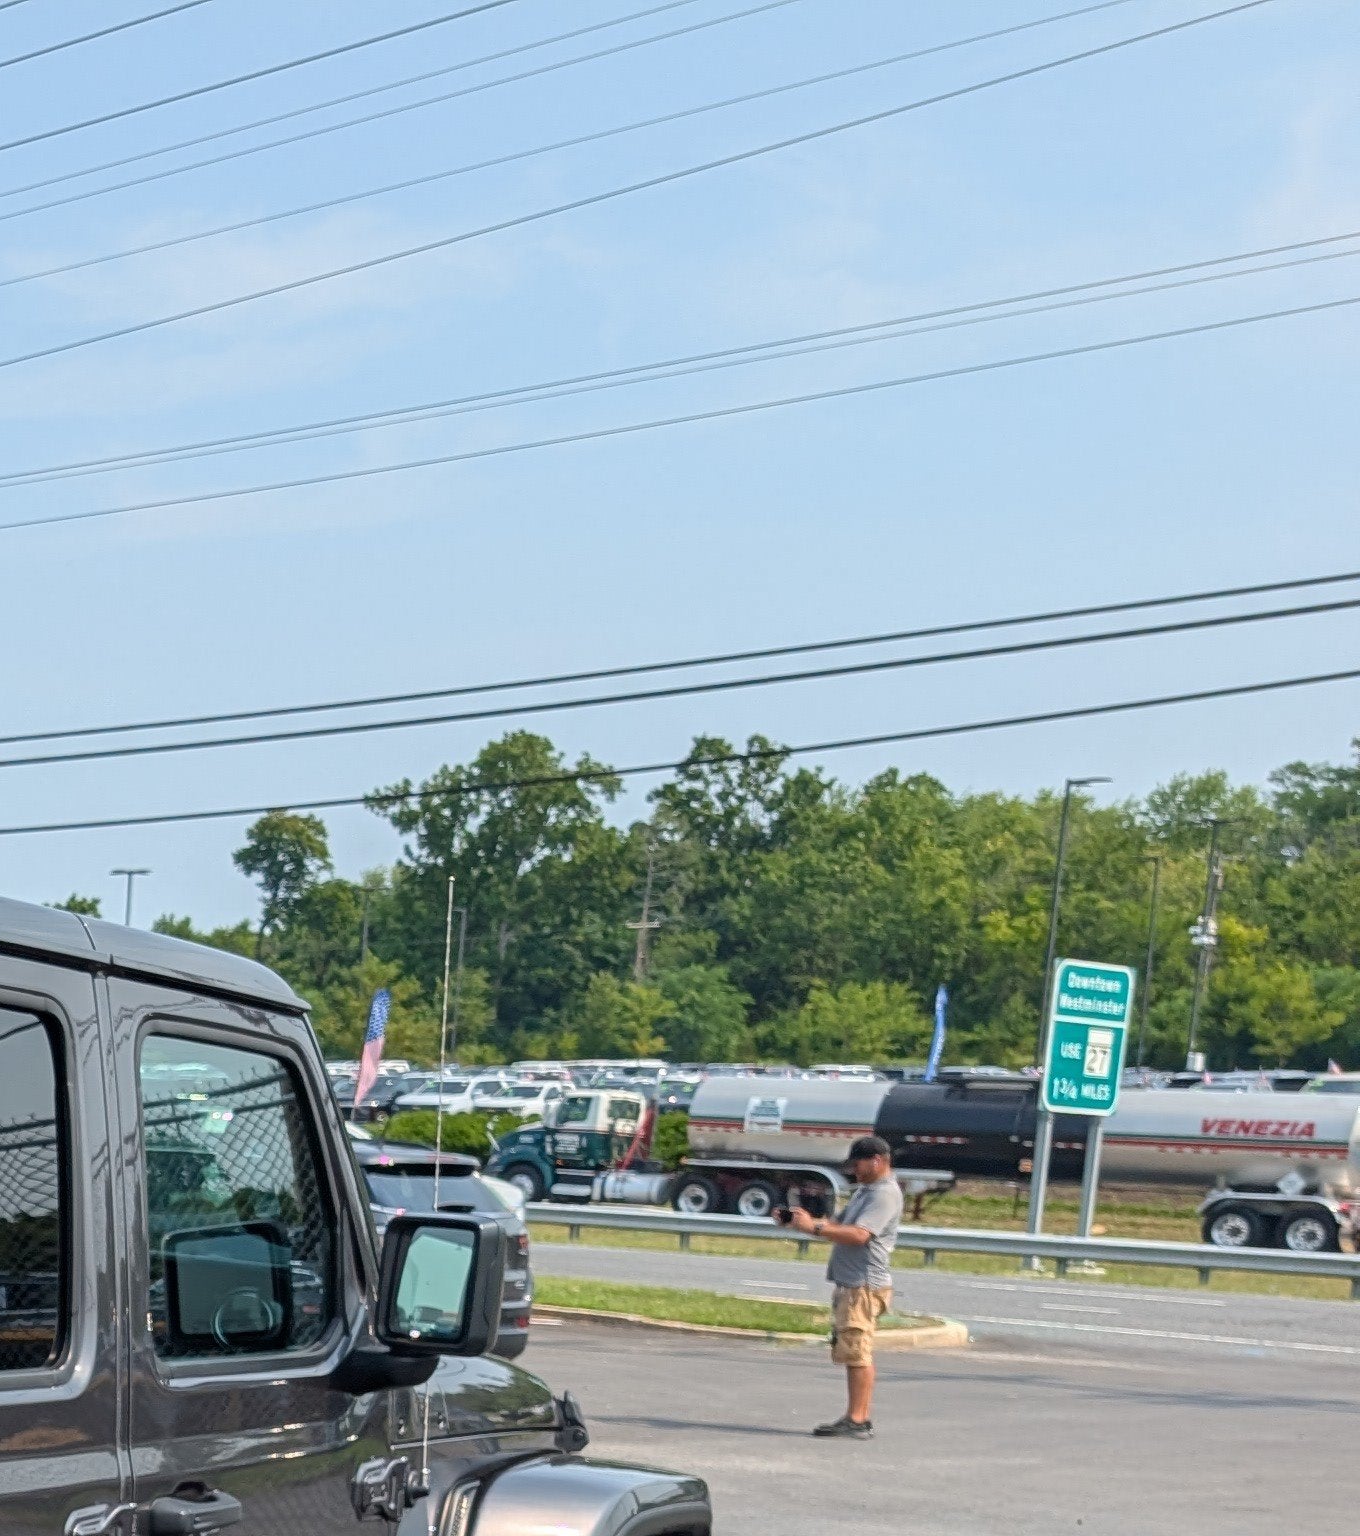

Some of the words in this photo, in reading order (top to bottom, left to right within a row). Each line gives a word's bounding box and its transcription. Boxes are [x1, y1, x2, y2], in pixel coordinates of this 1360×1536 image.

[1067, 971, 1122, 994] Downtown
[1059, 993, 1125, 1017] Westminster
[1060, 1041, 1082, 1060] USE
[1081, 1083, 1112, 1102] MILES
[1200, 1117, 1316, 1138] VENEZIA
